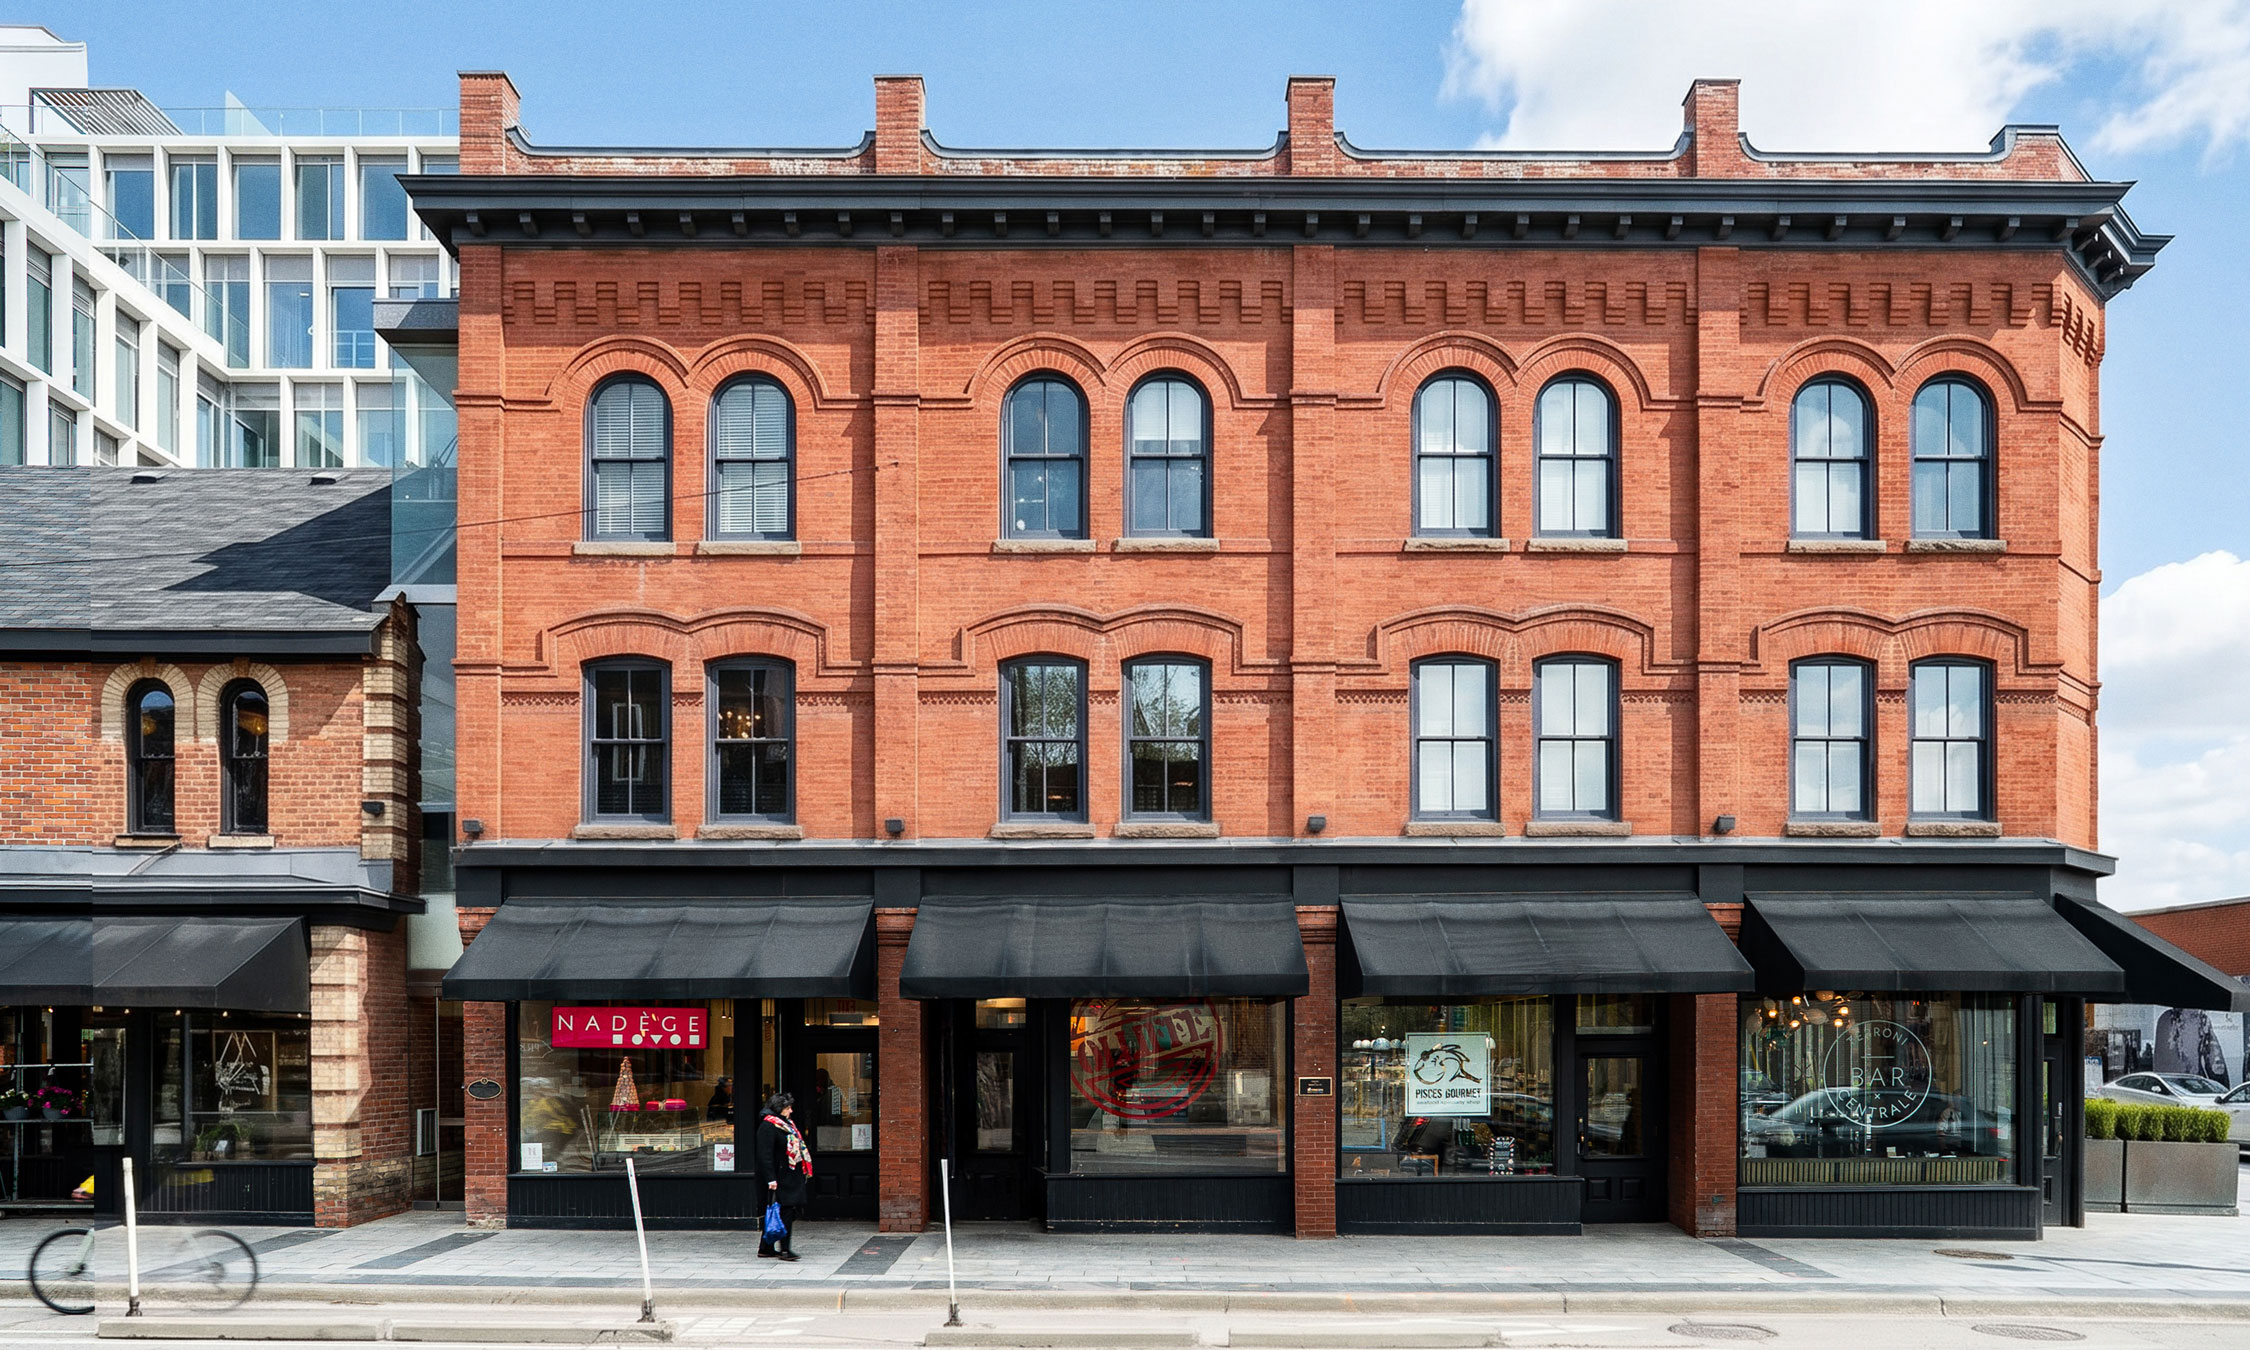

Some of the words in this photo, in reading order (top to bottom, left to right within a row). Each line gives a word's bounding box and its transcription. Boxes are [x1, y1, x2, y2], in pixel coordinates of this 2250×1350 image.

[558, 1011, 699, 1032] NADÈGE
[1851, 1067, 1905, 1087] BAR
[1416, 1088, 1443, 1099] PISCES
[1446, 1088, 1482, 1099] GOURMET
[1838, 1089, 1917, 1119] CENTRALE
